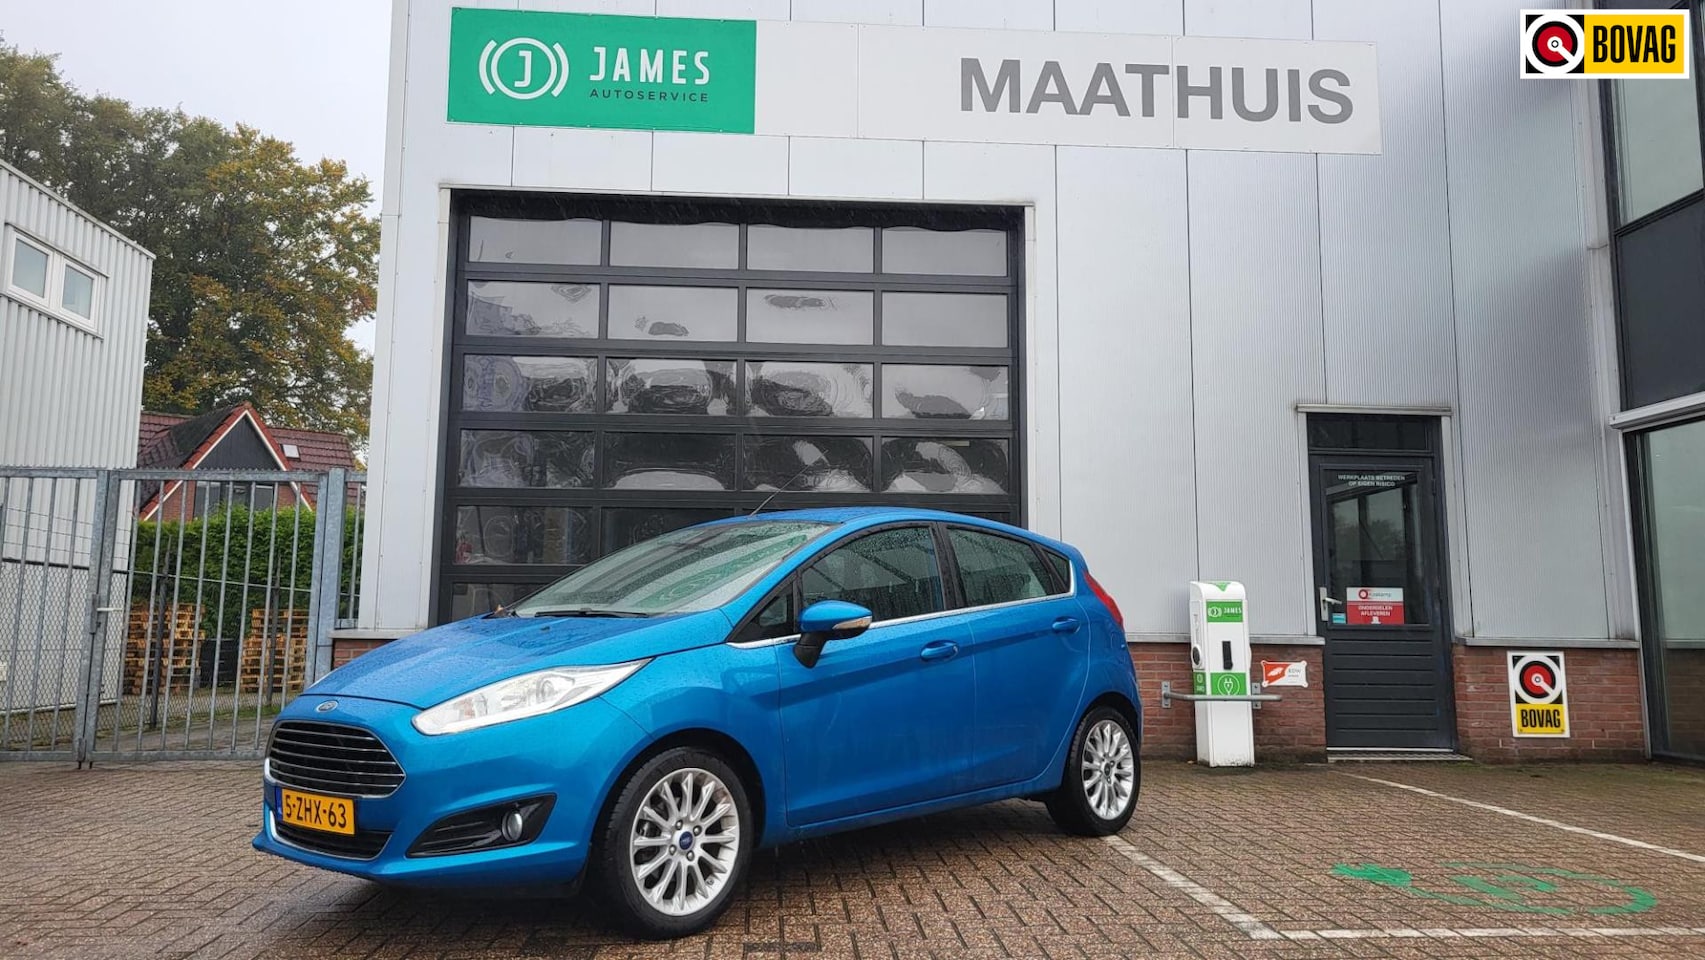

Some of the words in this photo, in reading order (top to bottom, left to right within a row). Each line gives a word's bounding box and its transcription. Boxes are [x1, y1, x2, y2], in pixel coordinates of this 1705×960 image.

[589, 46, 711, 86] JAMES
[589, 88, 710, 103] AUTOSERVICE
[960, 57, 1354, 125] MAATHUIS
[1223, 607, 1242, 615] JAMES
[1520, 709, 1561, 728] BOVAG
[285, 794, 347, 829] 5-ZHX-63
